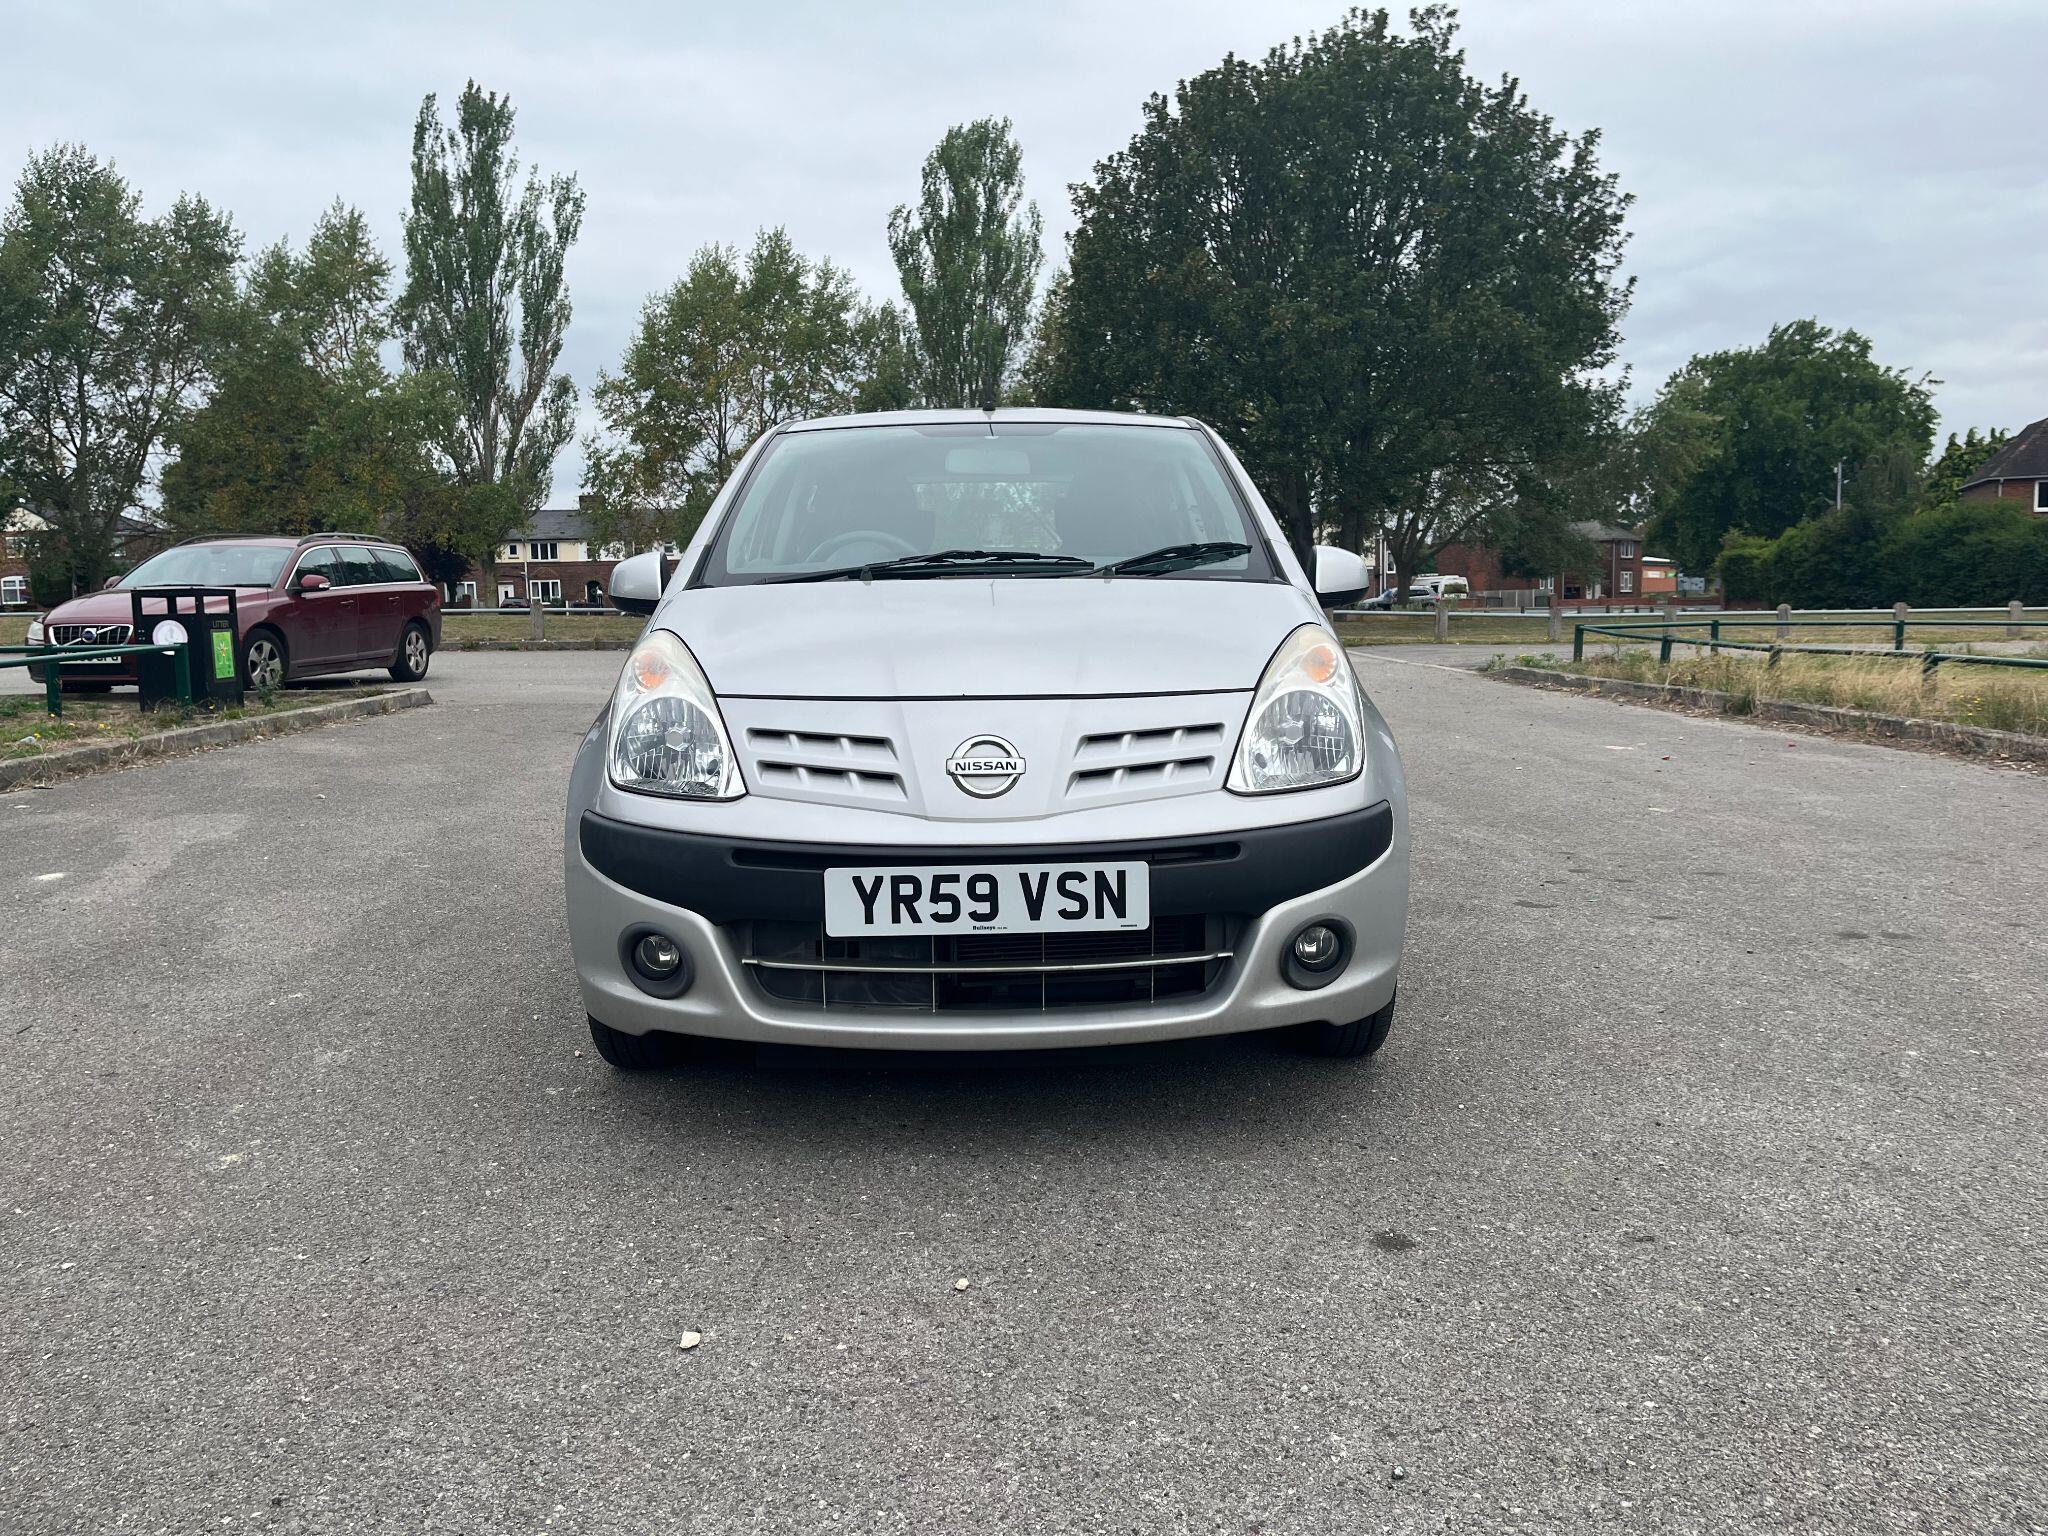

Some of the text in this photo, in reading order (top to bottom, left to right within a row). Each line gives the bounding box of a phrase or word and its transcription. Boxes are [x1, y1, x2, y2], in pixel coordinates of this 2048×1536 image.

[955, 761, 1017, 772] NISSAN
[852, 870, 1127, 925] YR59 VSN
